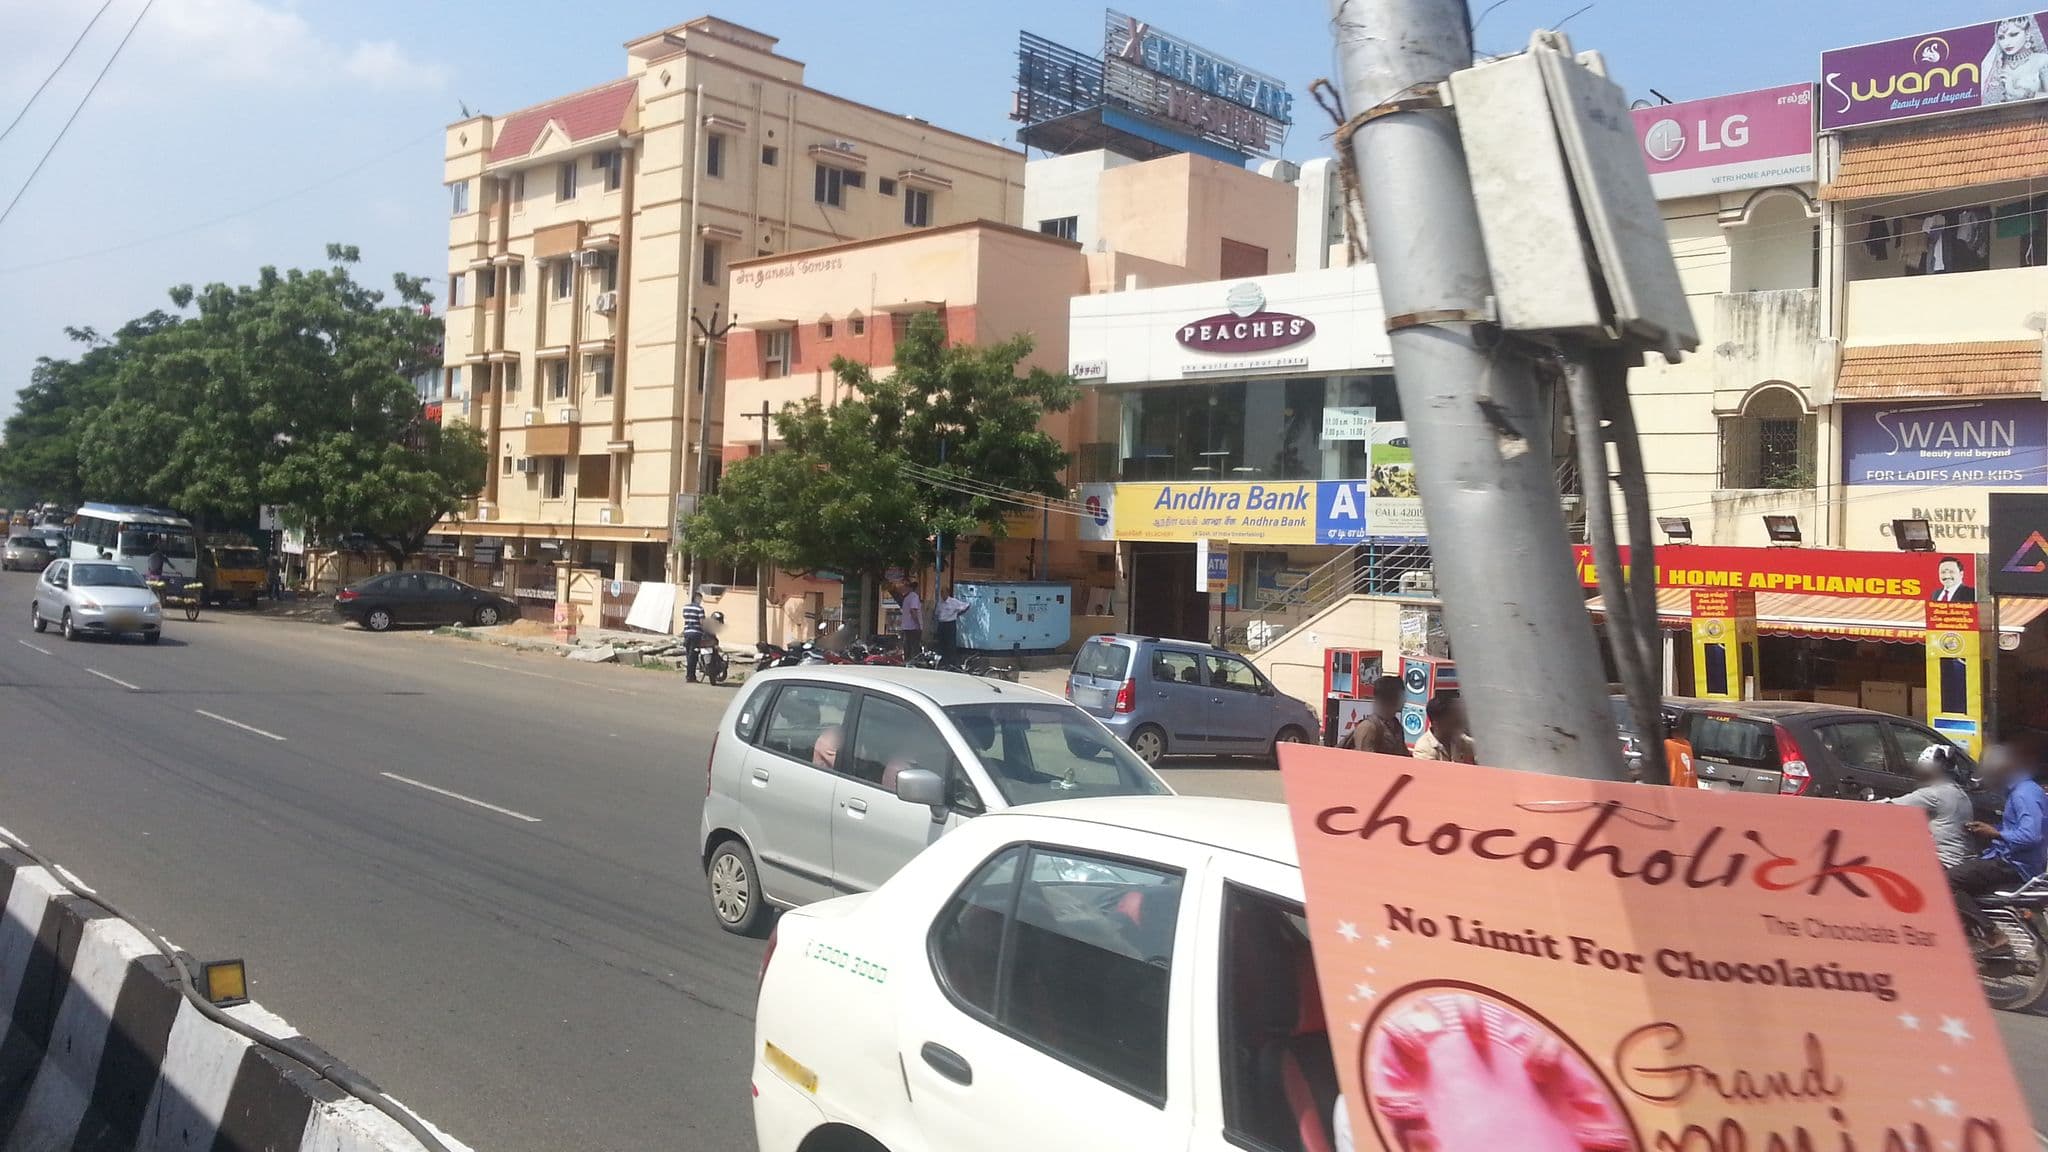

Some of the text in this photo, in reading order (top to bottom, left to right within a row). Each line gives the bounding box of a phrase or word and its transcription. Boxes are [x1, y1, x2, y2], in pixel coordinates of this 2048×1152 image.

[1890, 98, 1920, 110] Beauty
[1921, 95, 1939, 105] and
[1698, 114, 1749, 152] LG
[1711, 165, 1812, 184] VETRI HOME APPLIANCES
[1184, 320, 1303, 342] PEACHES
[1249, 360, 1271, 368] your
[1276, 358, 1304, 367] plate
[1875, 412, 2015, 456] SWANN
[1920, 448, 2011, 458] Beauty and beyond
[1866, 470, 2023, 481] FOR LADIES AND KIDS
[1154, 485, 1310, 510] Andhra Bank
[1242, 516, 1306, 527] Andhra Bank
[1375, 508, 1398, 518] CALL
[1208, 558, 1227, 570] ATM
[1669, 569, 1743, 587] HOME
[1748, 572, 1921, 596] APPLIANCES
[1848, 626, 1894, 638] HOME
[1761, 914, 1938, 948] The Chocolate Bar
[1384, 903, 1898, 1001] No Limit For Chocolating
[1614, 1022, 1843, 1101] Grand
